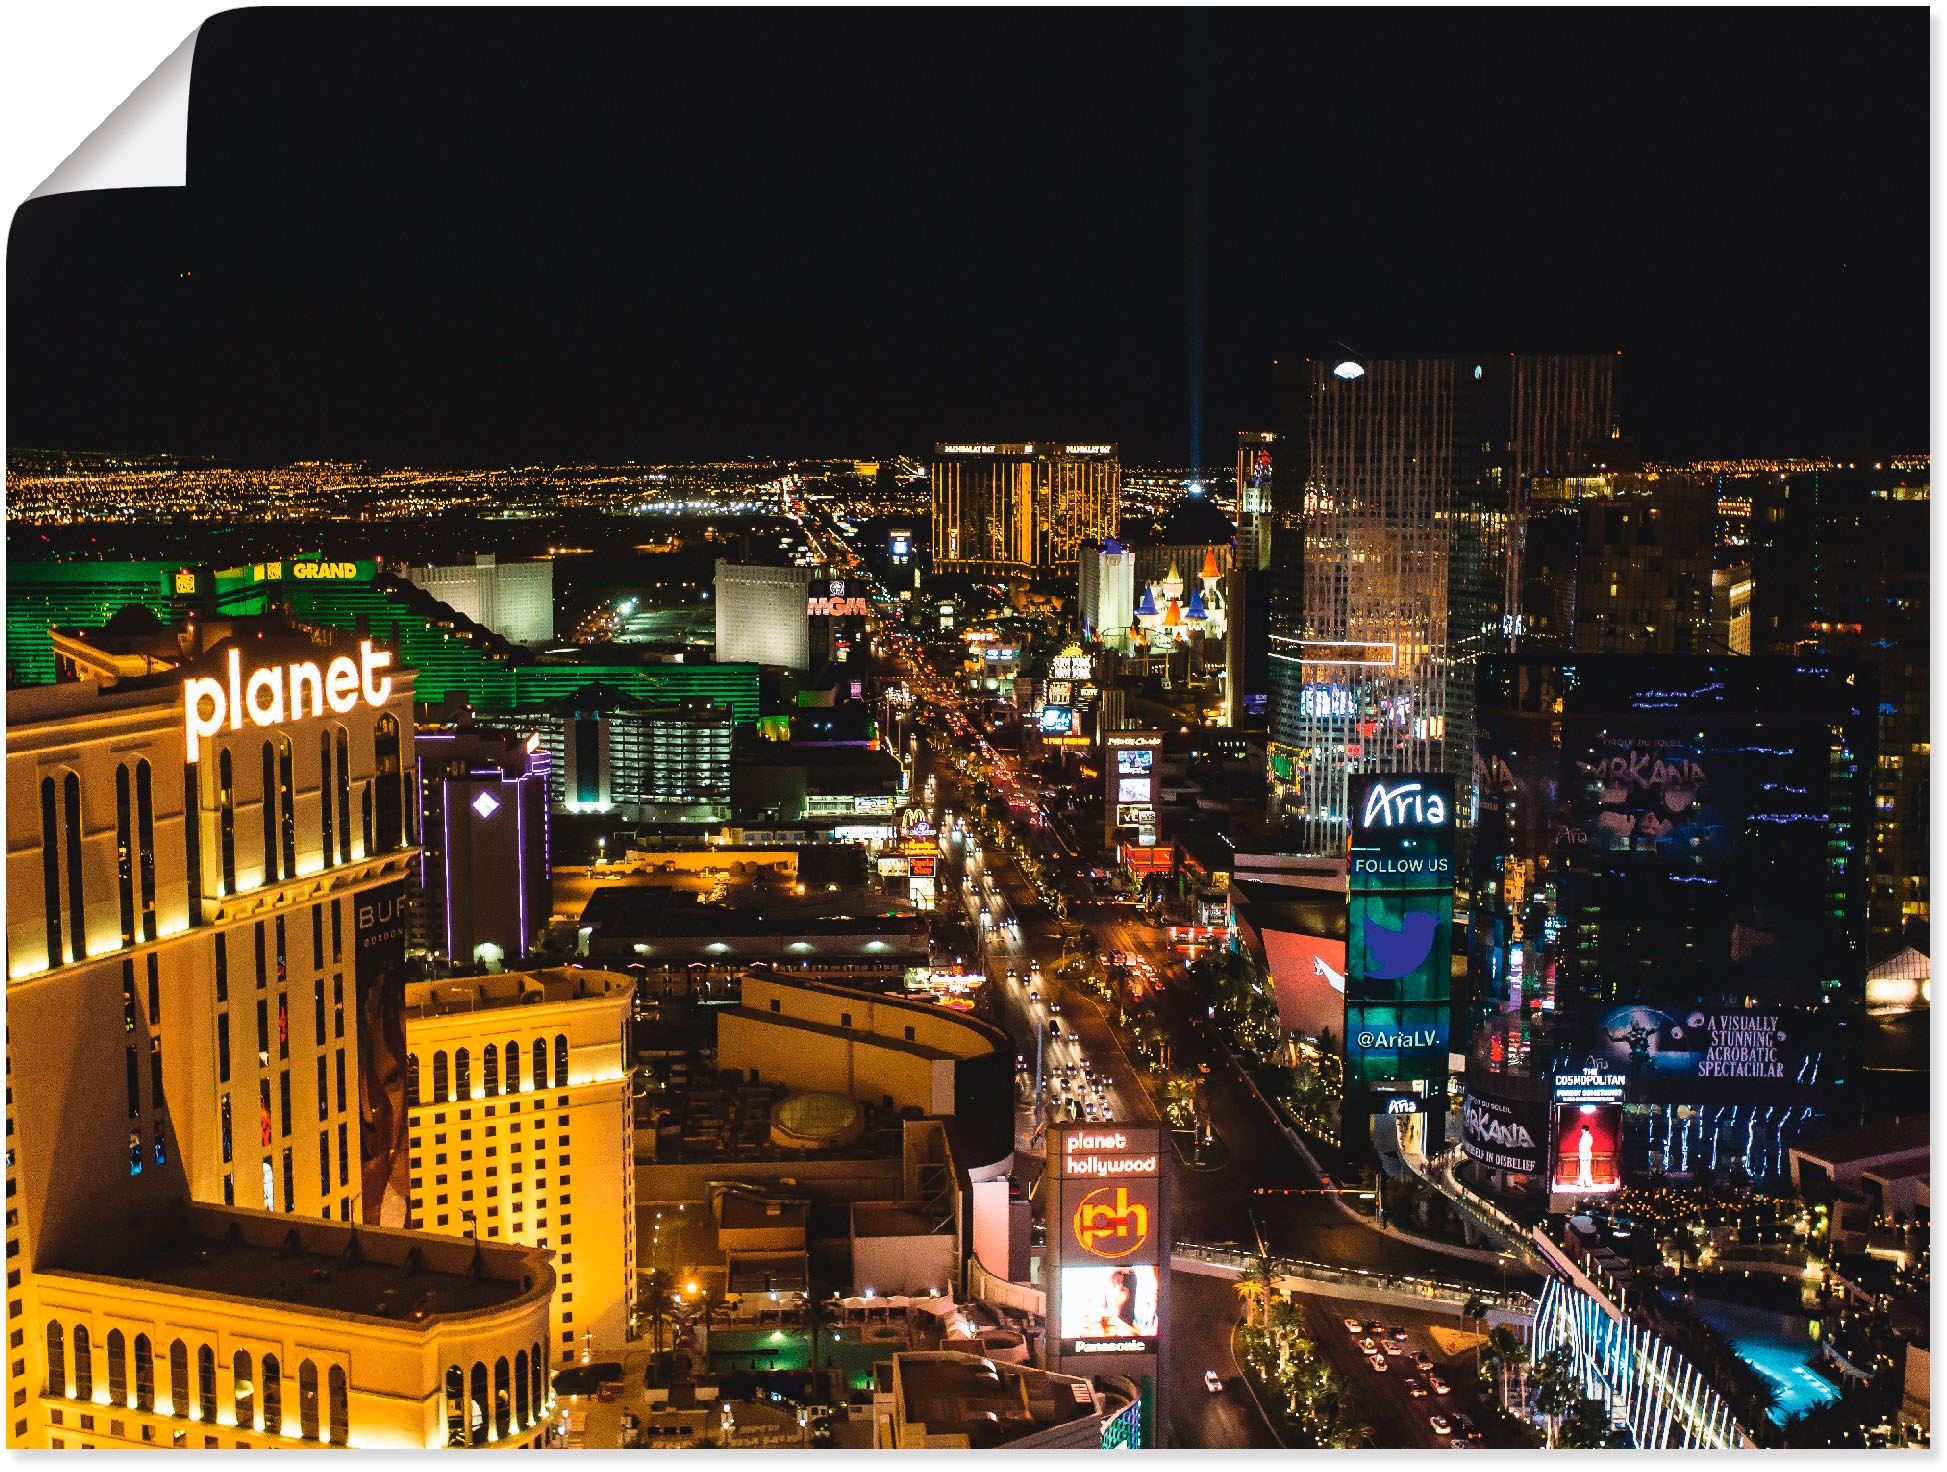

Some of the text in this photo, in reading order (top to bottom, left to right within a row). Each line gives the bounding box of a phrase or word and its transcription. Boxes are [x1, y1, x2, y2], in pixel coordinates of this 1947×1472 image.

[293, 562, 357, 579] GRAND
[807, 596, 867, 616] MGM
[184, 640, 392, 764] planet
[1363, 783, 1445, 828] Aria
[1356, 858, 1448, 873] FOLLOW US
[1707, 1015, 1779, 1032] A VISUALLY
[1711, 1030, 1773, 1048] STUNNING
[1706, 1046, 1777, 1063] ACROBATIC
[1582, 1067, 1599, 1076] THE
[1698, 1061, 1784, 1078] SPECTACULAR
[1555, 1075, 1626, 1087] COSMOPOLITAN
[1388, 1099, 1417, 1115] Aria
[1066, 1131, 1127, 1154] planet
[1066, 1155, 1156, 1177] hollywood
[1485, 1151, 1494, 1163] IN
[1494, 1154, 1537, 1172] DISBELIEF
